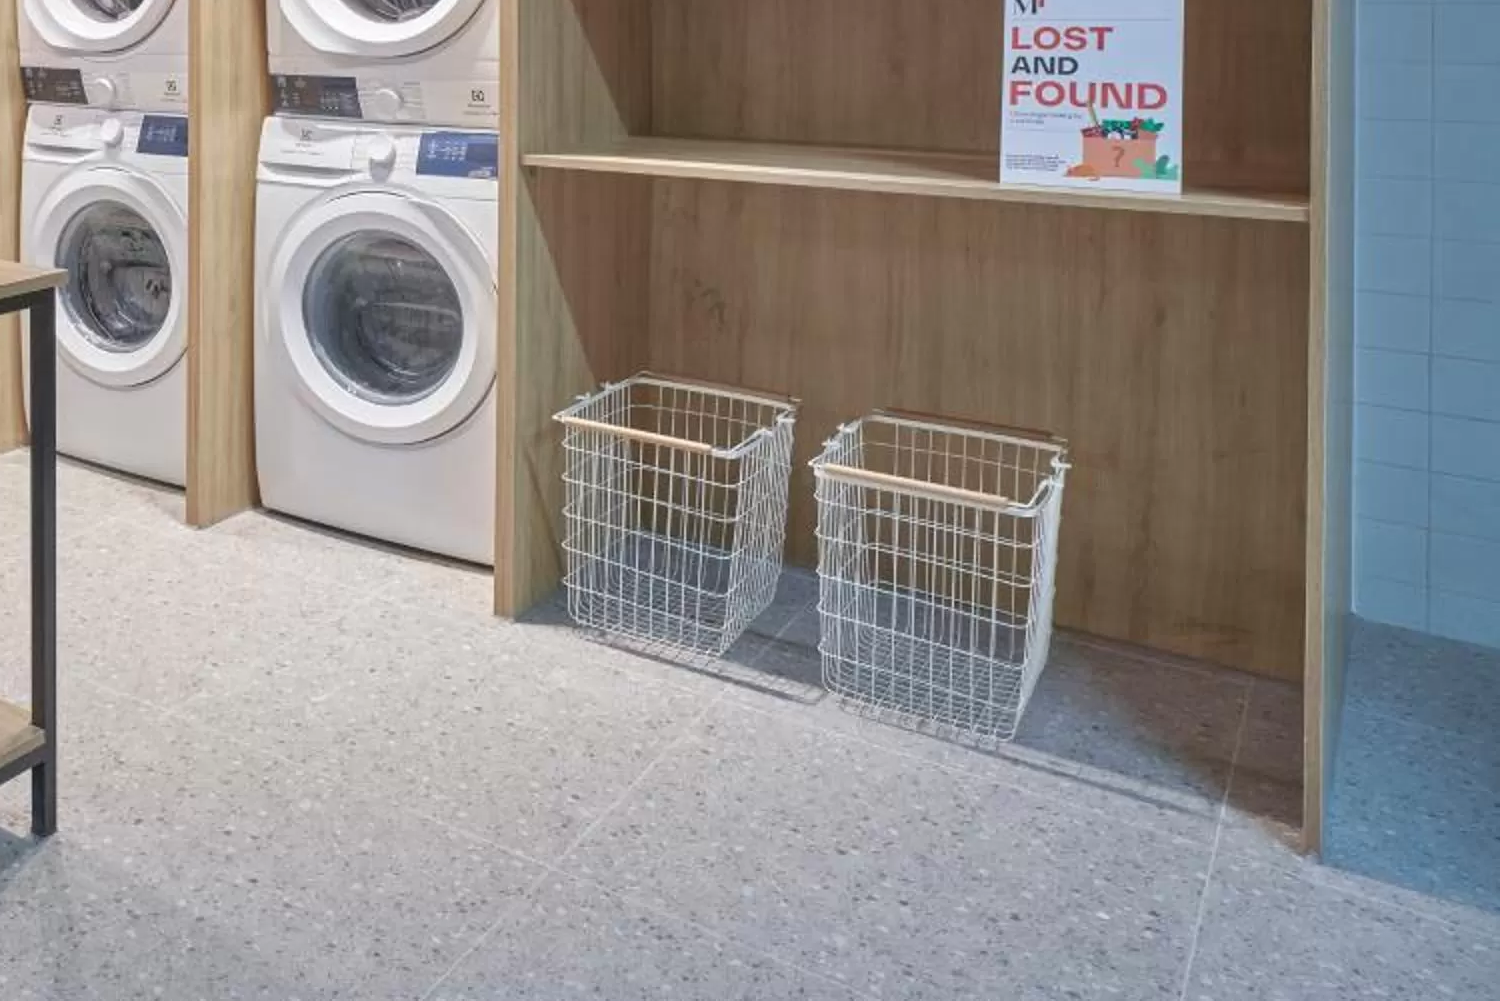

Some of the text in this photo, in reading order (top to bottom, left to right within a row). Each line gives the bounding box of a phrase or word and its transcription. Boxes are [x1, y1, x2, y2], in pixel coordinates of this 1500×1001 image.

[1011, 26, 1114, 51] LOST
[1011, 56, 1079, 75] AND
[1009, 80, 1168, 110] FOUND
